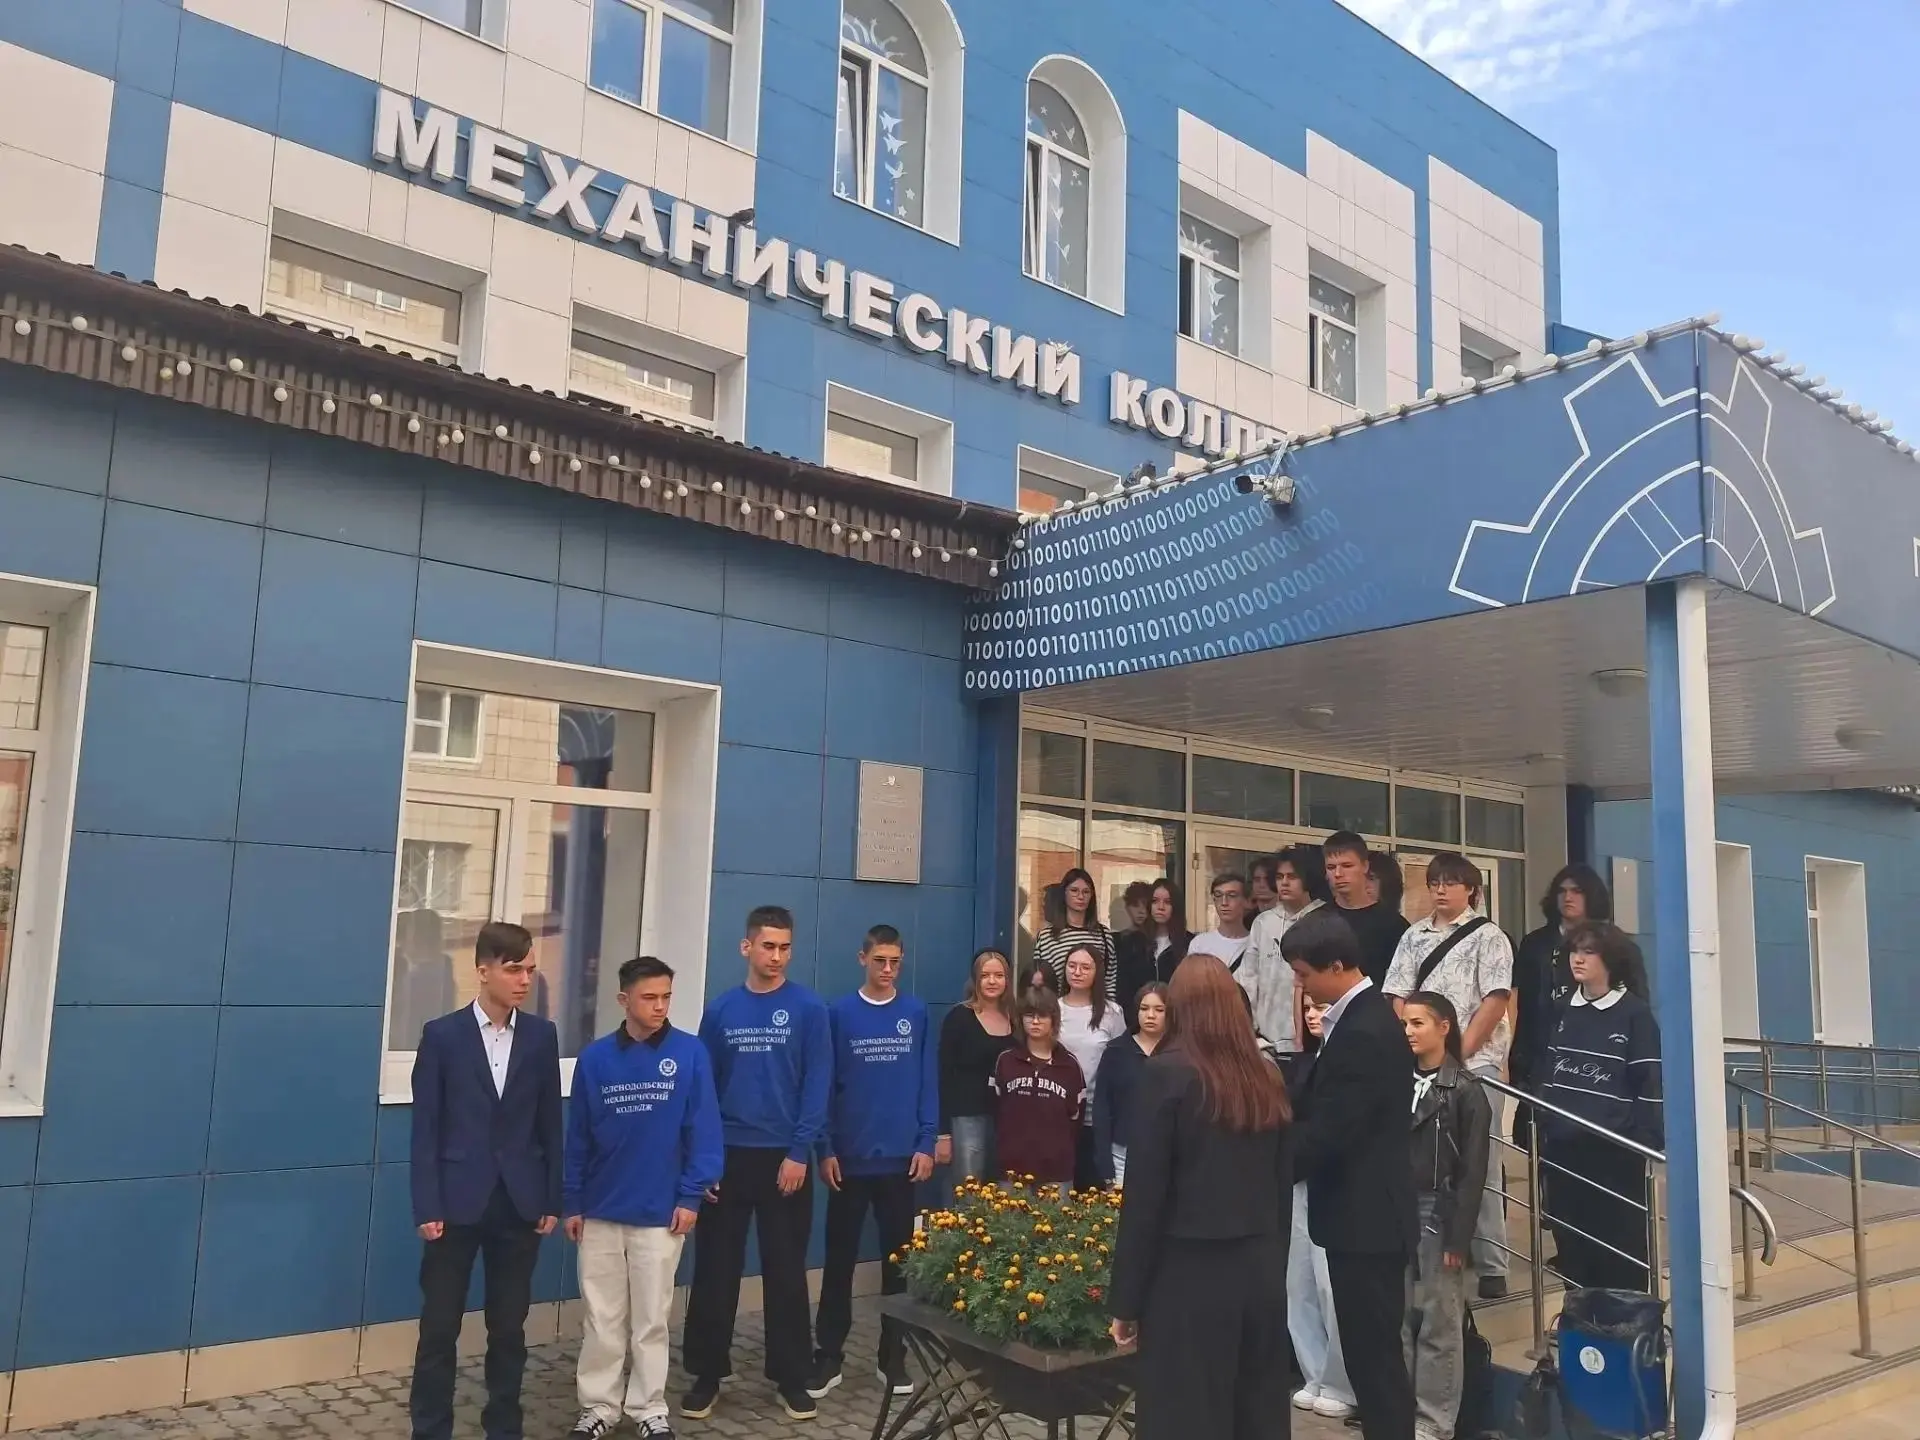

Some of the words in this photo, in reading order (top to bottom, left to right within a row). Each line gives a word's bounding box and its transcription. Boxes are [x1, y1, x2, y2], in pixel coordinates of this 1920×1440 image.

[373, 88, 1080, 405] МЕХАНИЧЕСКИЙ
[1006, 1077, 1033, 1093] SUPER
[1037, 1078, 1067, 1099] BRAVE
